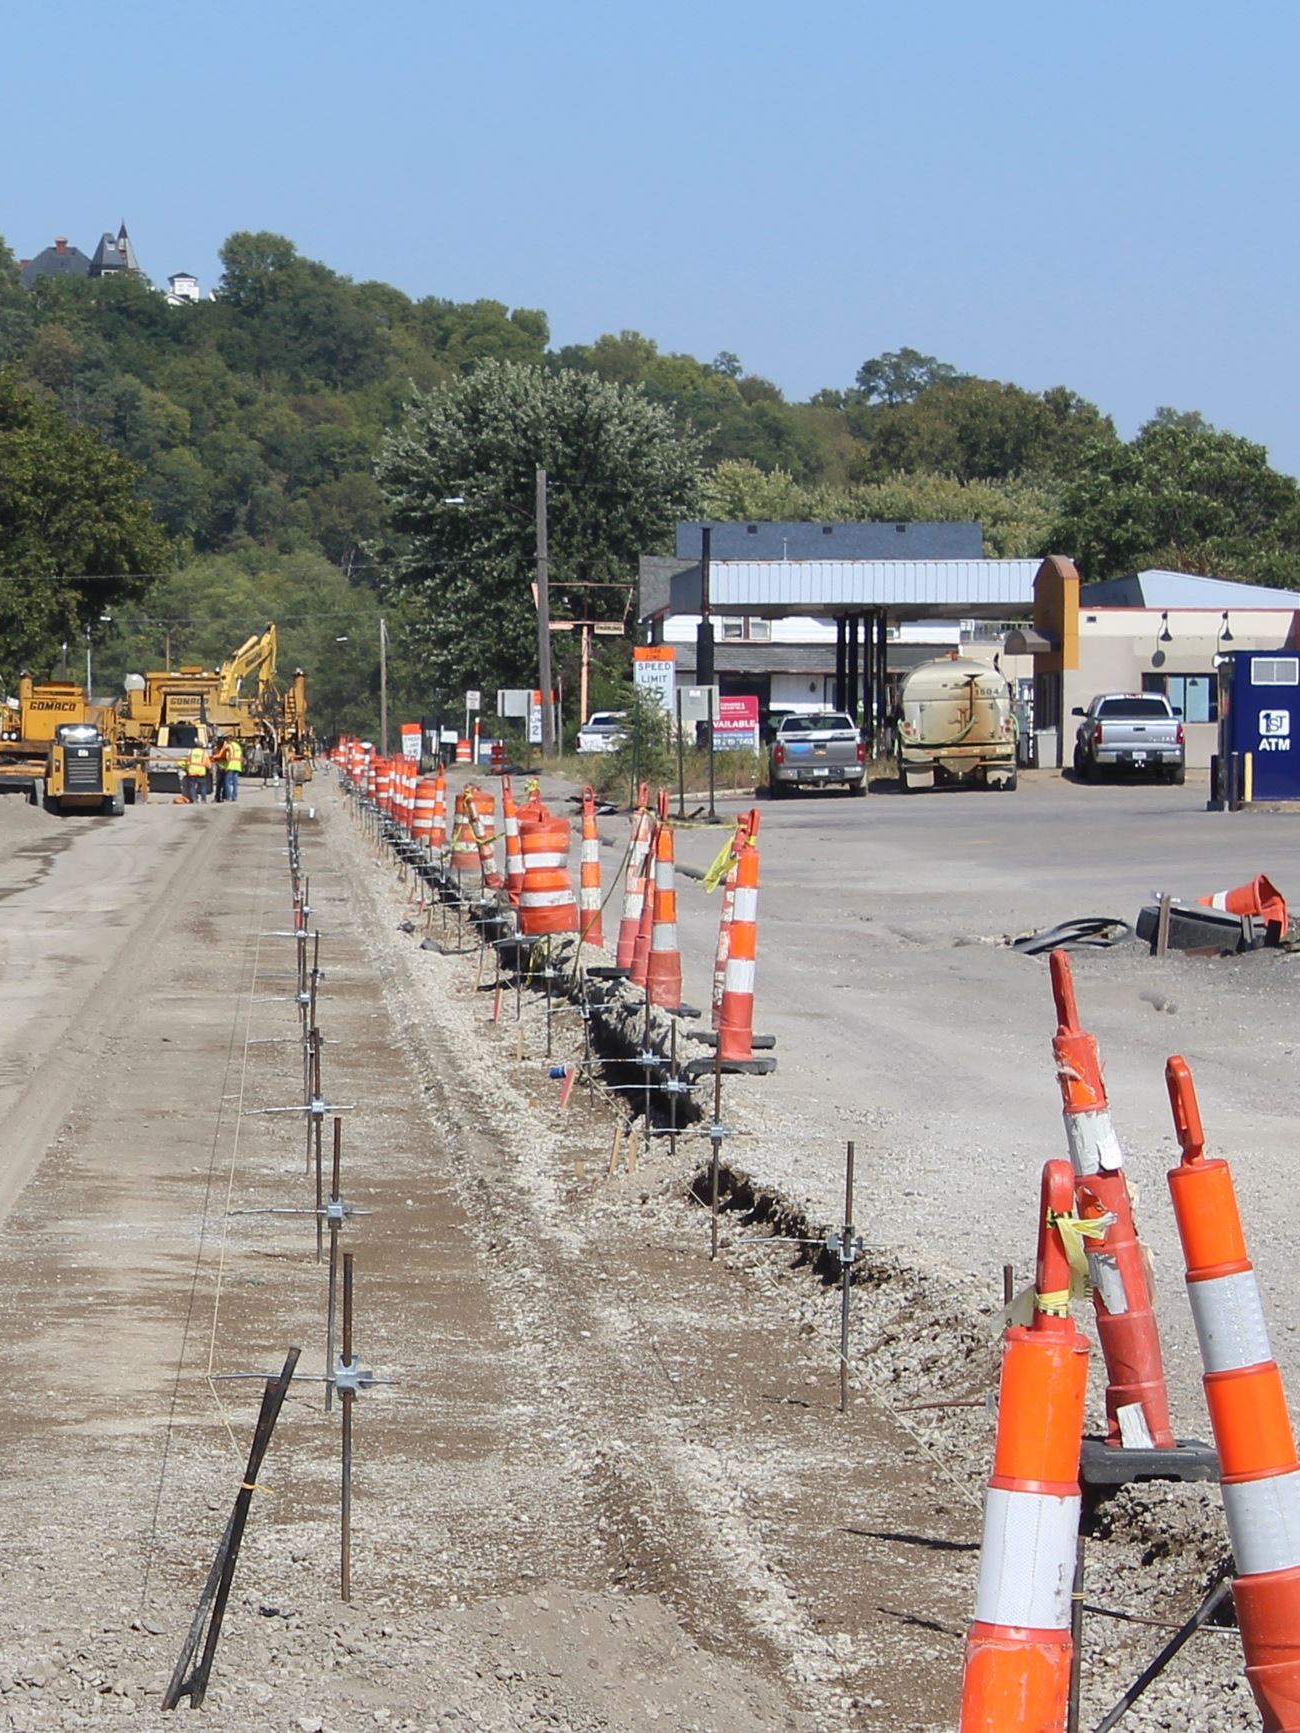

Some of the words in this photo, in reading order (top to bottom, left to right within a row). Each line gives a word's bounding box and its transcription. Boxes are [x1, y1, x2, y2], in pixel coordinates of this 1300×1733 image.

[638, 662, 671, 671] SPEED
[641, 675, 667, 683] LIMIT
[30, 701, 76, 711] GOMACO
[712, 720, 755, 728] VAILABLE
[1259, 738, 1290, 751] ATM
